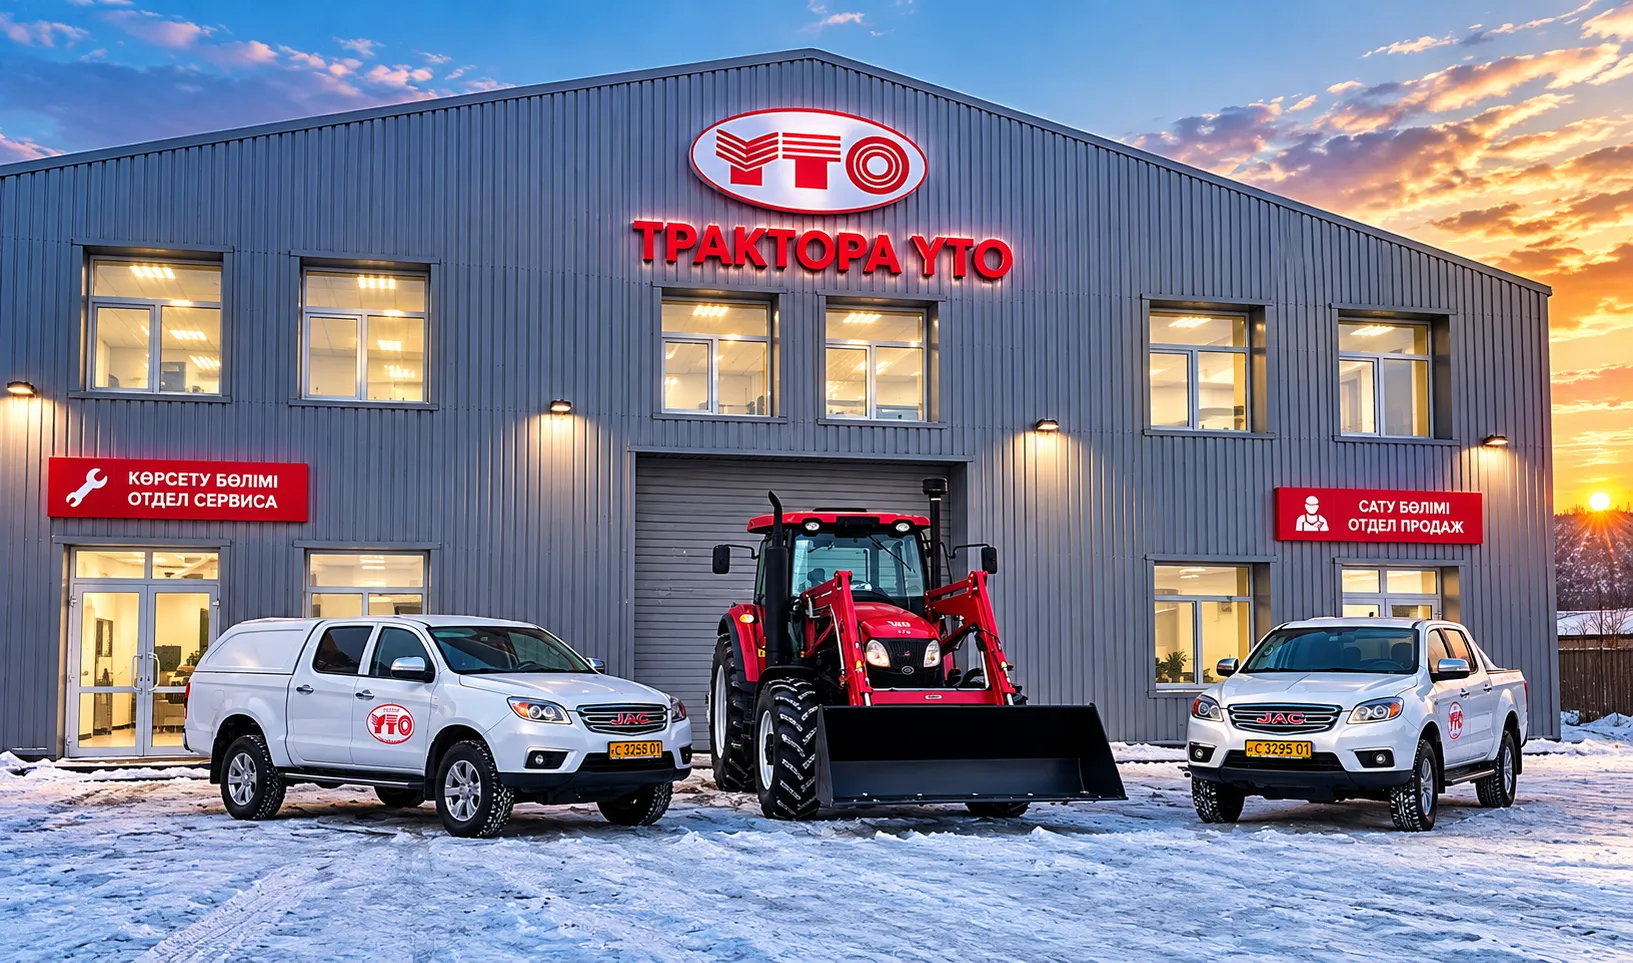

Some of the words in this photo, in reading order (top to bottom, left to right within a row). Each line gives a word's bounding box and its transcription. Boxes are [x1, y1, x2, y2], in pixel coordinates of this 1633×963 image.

[716, 128, 910, 196] YTO
[633, 219, 903, 276] ТРАКТОРА
[909, 235, 1013, 280] YTO
[128, 471, 211, 487] КӨРСЕТУ
[216, 473, 278, 489] БӨЛІМІ
[127, 491, 189, 509] ОТДЕЛ
[194, 493, 278, 509] СЕРВИСА
[1358, 499, 1396, 514] САТУ
[1399, 501, 1450, 515] БӨЛІМІ
[1348, 518, 1397, 534] ОТДЕЛ
[1401, 519, 1464, 535] ПРОДАЖ
[371, 713, 412, 737] YTO
[610, 711, 651, 725] JAC
[1256, 712, 1305, 725] JAC
[650, 742, 660, 755] 01
[1264, 743, 1293, 755] 3295
[1296, 743, 1309, 755] 01
